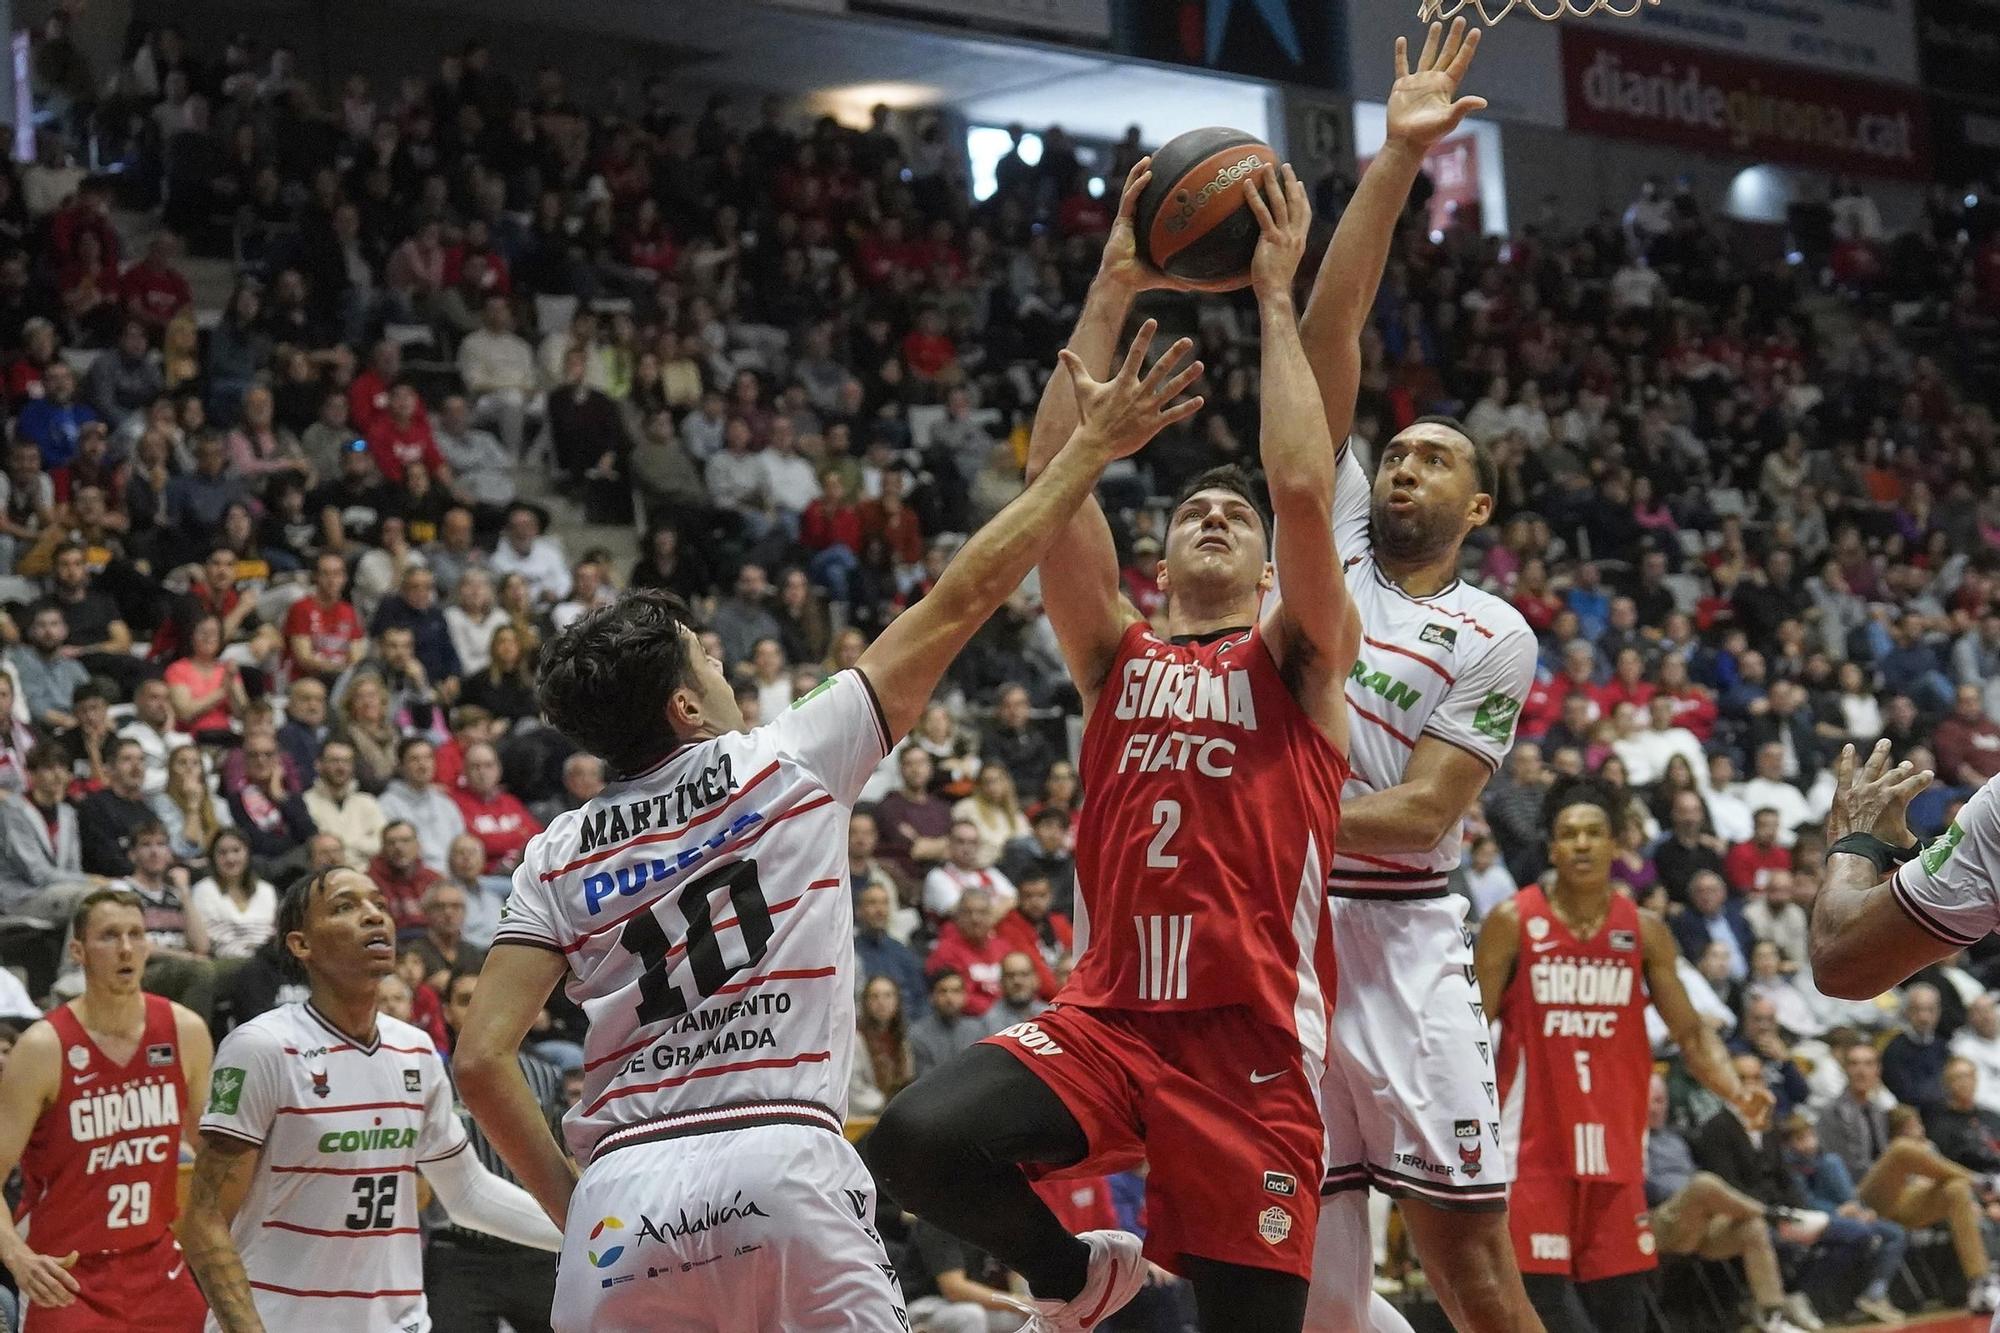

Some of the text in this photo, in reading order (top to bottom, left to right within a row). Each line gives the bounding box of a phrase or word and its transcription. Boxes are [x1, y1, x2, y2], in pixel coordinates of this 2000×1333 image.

[1115, 658, 1258, 731] GIRONA
[1117, 731, 1236, 778] FIATC
[1147, 800, 1182, 868] 2
[620, 858, 775, 1027] 10
[1530, 963, 1634, 1006] GIRONA
[1543, 1010, 1618, 1038] FIATC
[1574, 1050, 1592, 1094] 5
[69, 1082, 180, 1142] GIRONA
[86, 1135, 170, 1175] FIATC
[318, 1127, 419, 1153] COVIRA
[107, 1181, 151, 1229] 29
[345, 1175, 398, 1230] 32
[1267, 1180, 1289, 1193] acb
[635, 1190, 770, 1247] Andalucía
[1260, 1224, 1287, 1237] GIRONA
